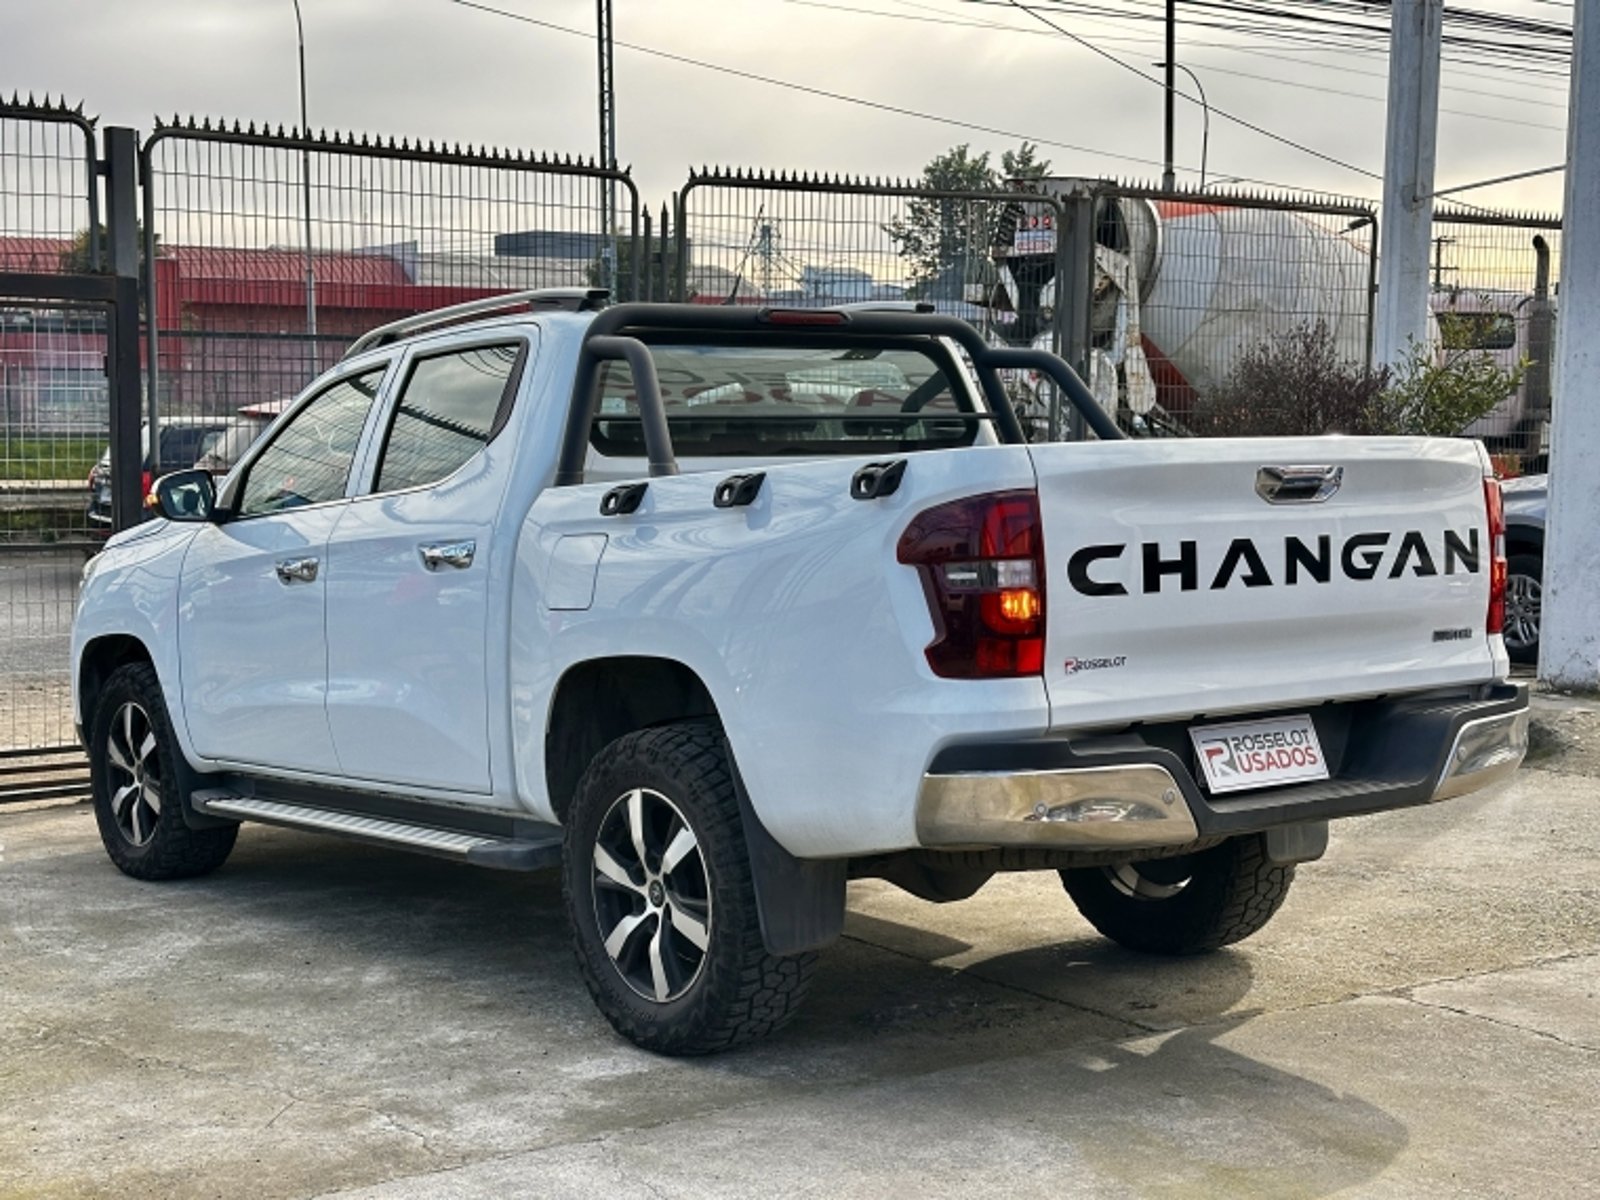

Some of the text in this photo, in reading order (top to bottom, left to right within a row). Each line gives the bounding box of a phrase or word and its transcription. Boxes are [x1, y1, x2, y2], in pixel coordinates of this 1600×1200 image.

[1066, 528, 1479, 597] CHANGAN
[1231, 729, 1310, 752] ROSSELOT
[1237, 746, 1318, 773] USADOS
